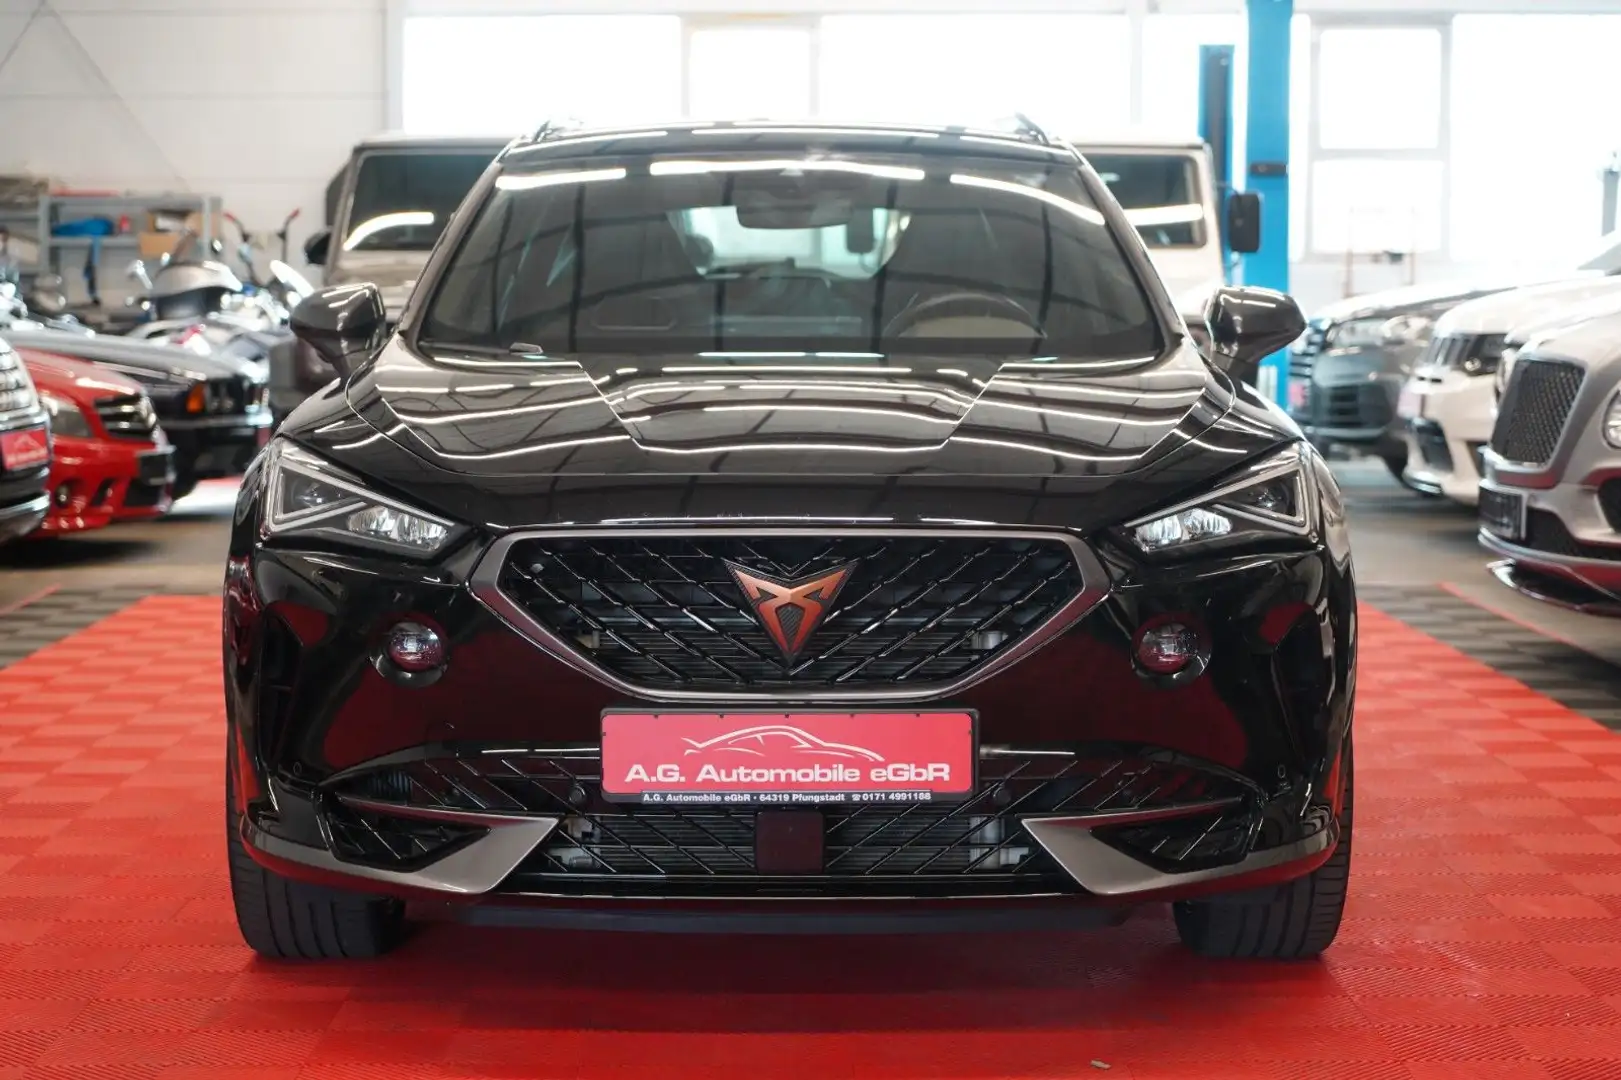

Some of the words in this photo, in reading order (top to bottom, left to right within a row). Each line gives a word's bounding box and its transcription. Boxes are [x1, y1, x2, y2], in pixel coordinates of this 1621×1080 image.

[624, 763, 686, 783] A.G.
[695, 763, 861, 783] Automobile
[870, 763, 950, 782] eGbR
[643, 793, 664, 802] A.G.
[666, 793, 722, 802] Automobile
[724, 793, 751, 802] eGbR
[759, 793, 789, 802] 64319
[792, 793, 845, 803] Pfungstadt
[862, 792, 886, 801] 0171
